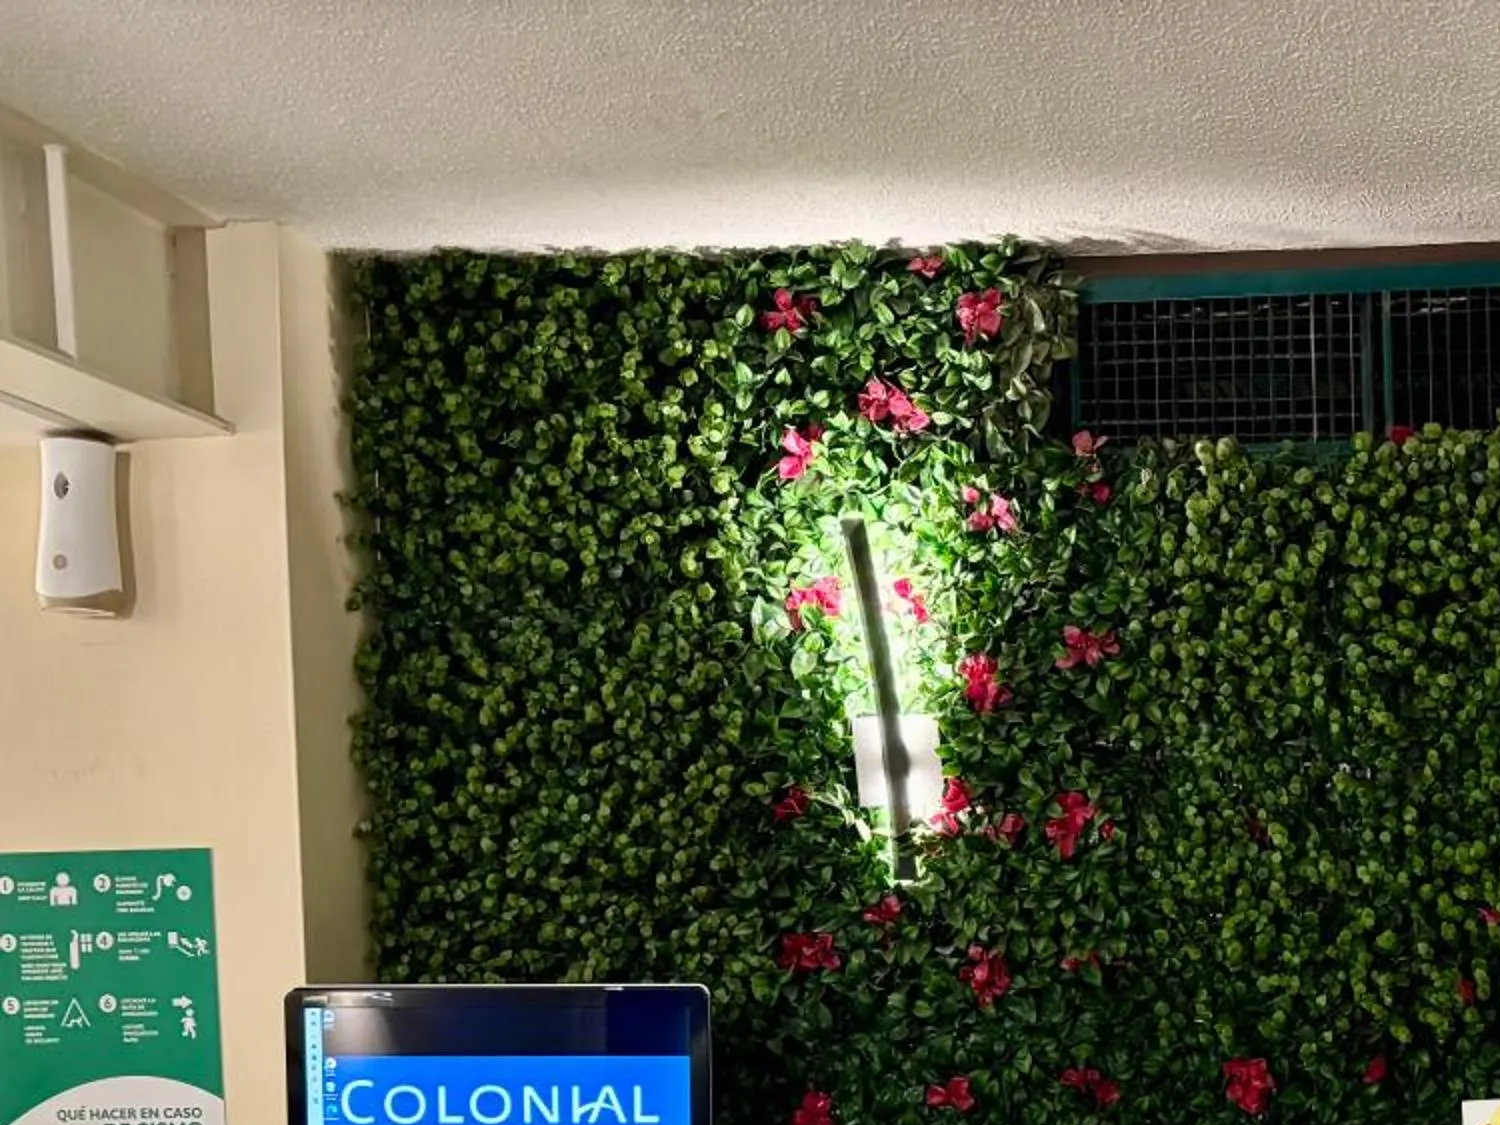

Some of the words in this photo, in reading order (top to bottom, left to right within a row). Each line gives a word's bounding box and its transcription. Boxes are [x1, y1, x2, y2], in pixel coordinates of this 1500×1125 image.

[57, 1105, 86, 1123] QUÉ
[89, 1107, 137, 1121] HACER
[140, 1107, 159, 1119] EN
[163, 1107, 203, 1119] CASO
[340, 1079, 660, 1125] COLONIAL
